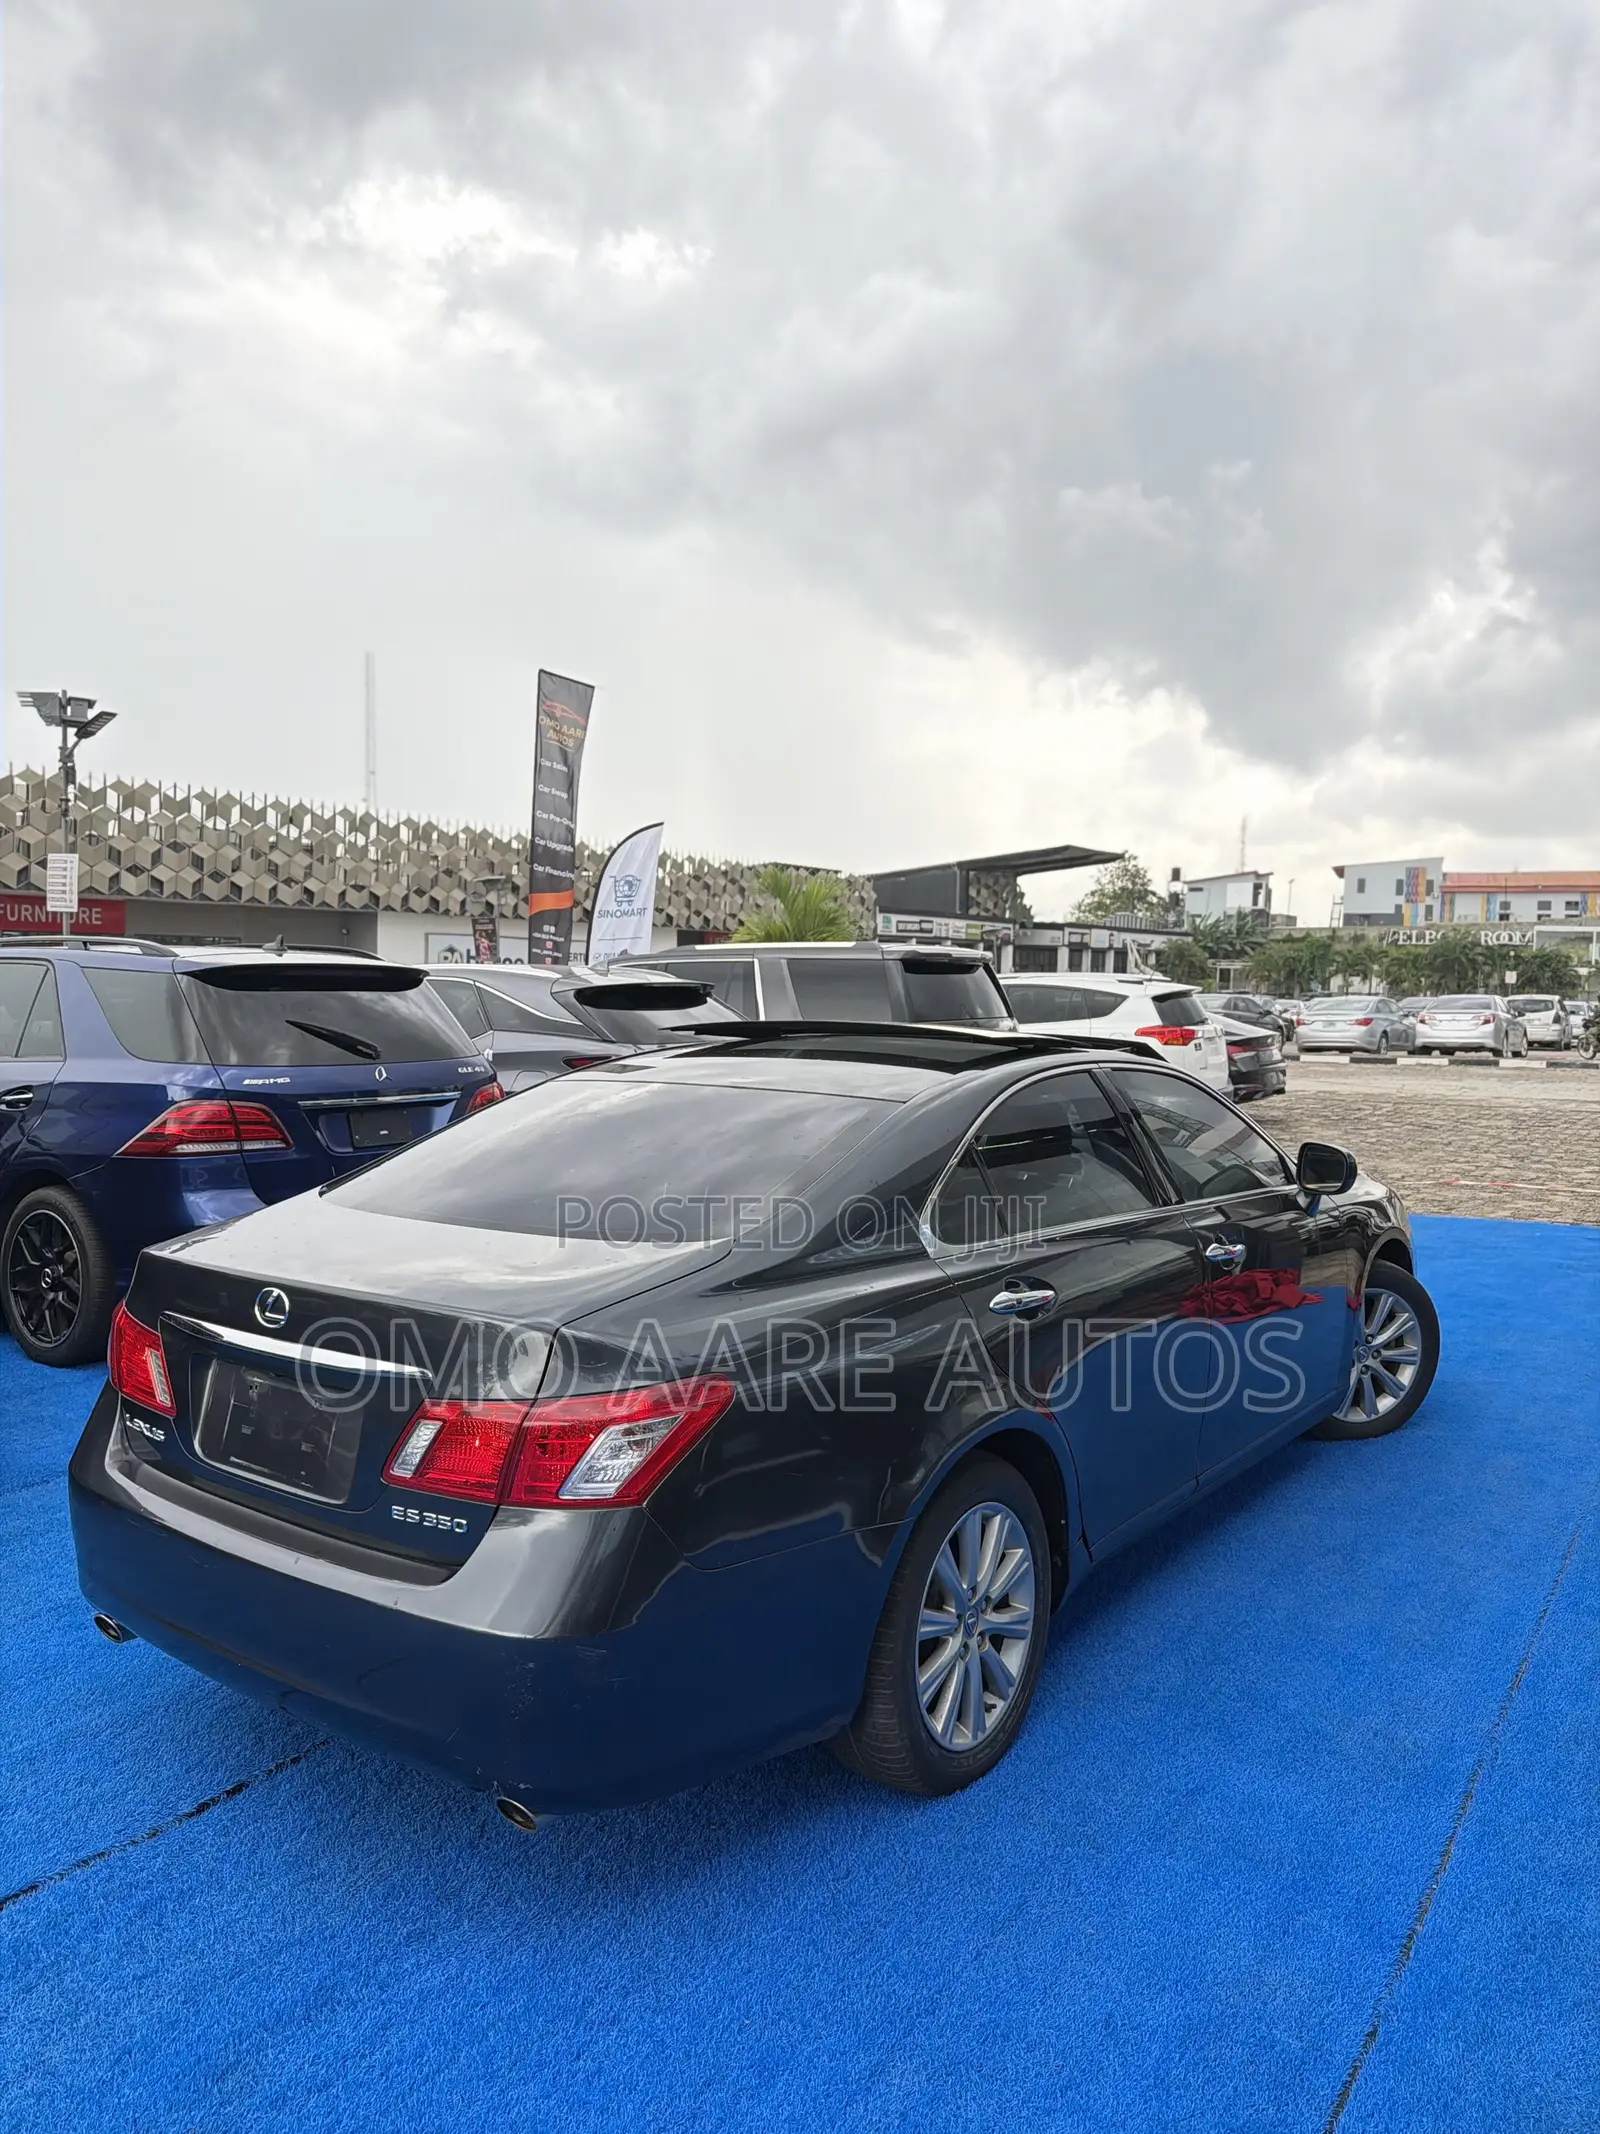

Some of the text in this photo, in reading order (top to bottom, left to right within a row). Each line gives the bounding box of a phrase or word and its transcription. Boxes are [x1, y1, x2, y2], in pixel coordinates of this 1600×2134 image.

[538, 716, 561, 730] OMO
[546, 730, 575, 748] AUTOS
[540, 758, 552, 767] Car
[538, 784, 569, 799] Car Swap
[536, 810, 549, 819] Car
[534, 837, 547, 846] Car
[533, 863, 545, 872] Car
[597, 907, 648, 919] SINOMART
[1480, 930, 1534, 946] ROOM
[125, 1413, 165, 1442] LEXUS
